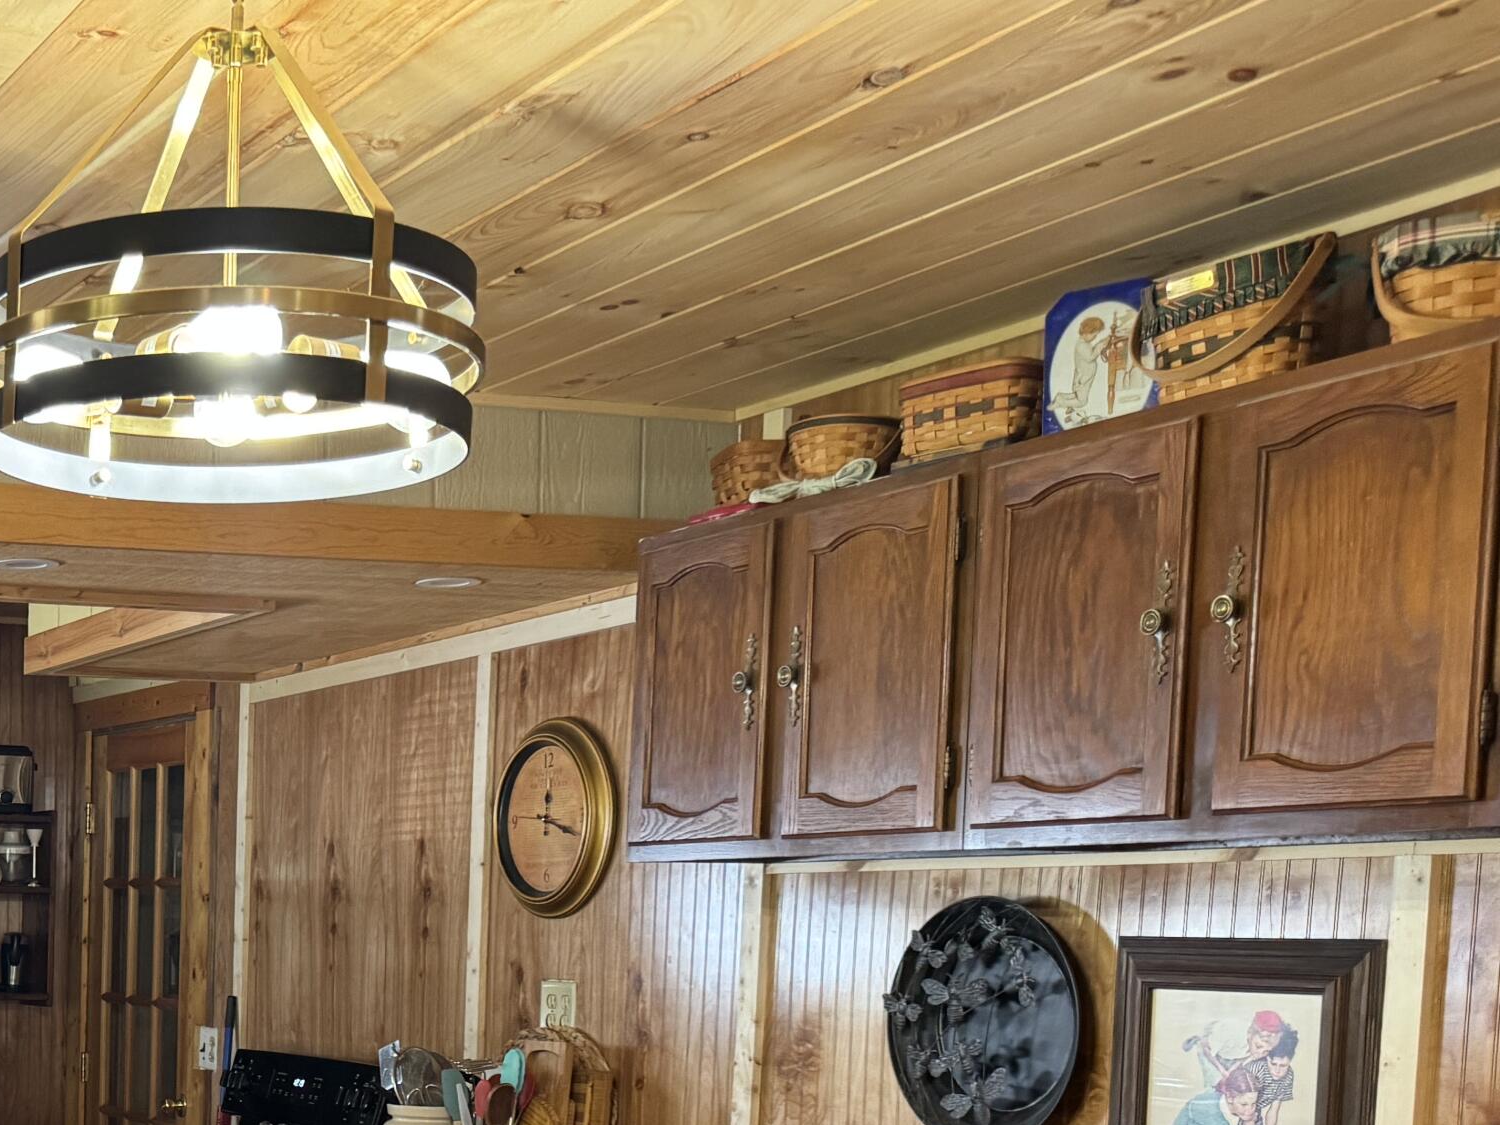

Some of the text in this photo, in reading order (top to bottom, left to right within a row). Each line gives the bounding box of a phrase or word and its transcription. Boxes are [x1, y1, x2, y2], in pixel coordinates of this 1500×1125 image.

[543, 752, 555, 769] 12
[511, 814, 518, 831] 9
[543, 868, 550, 883] 6
